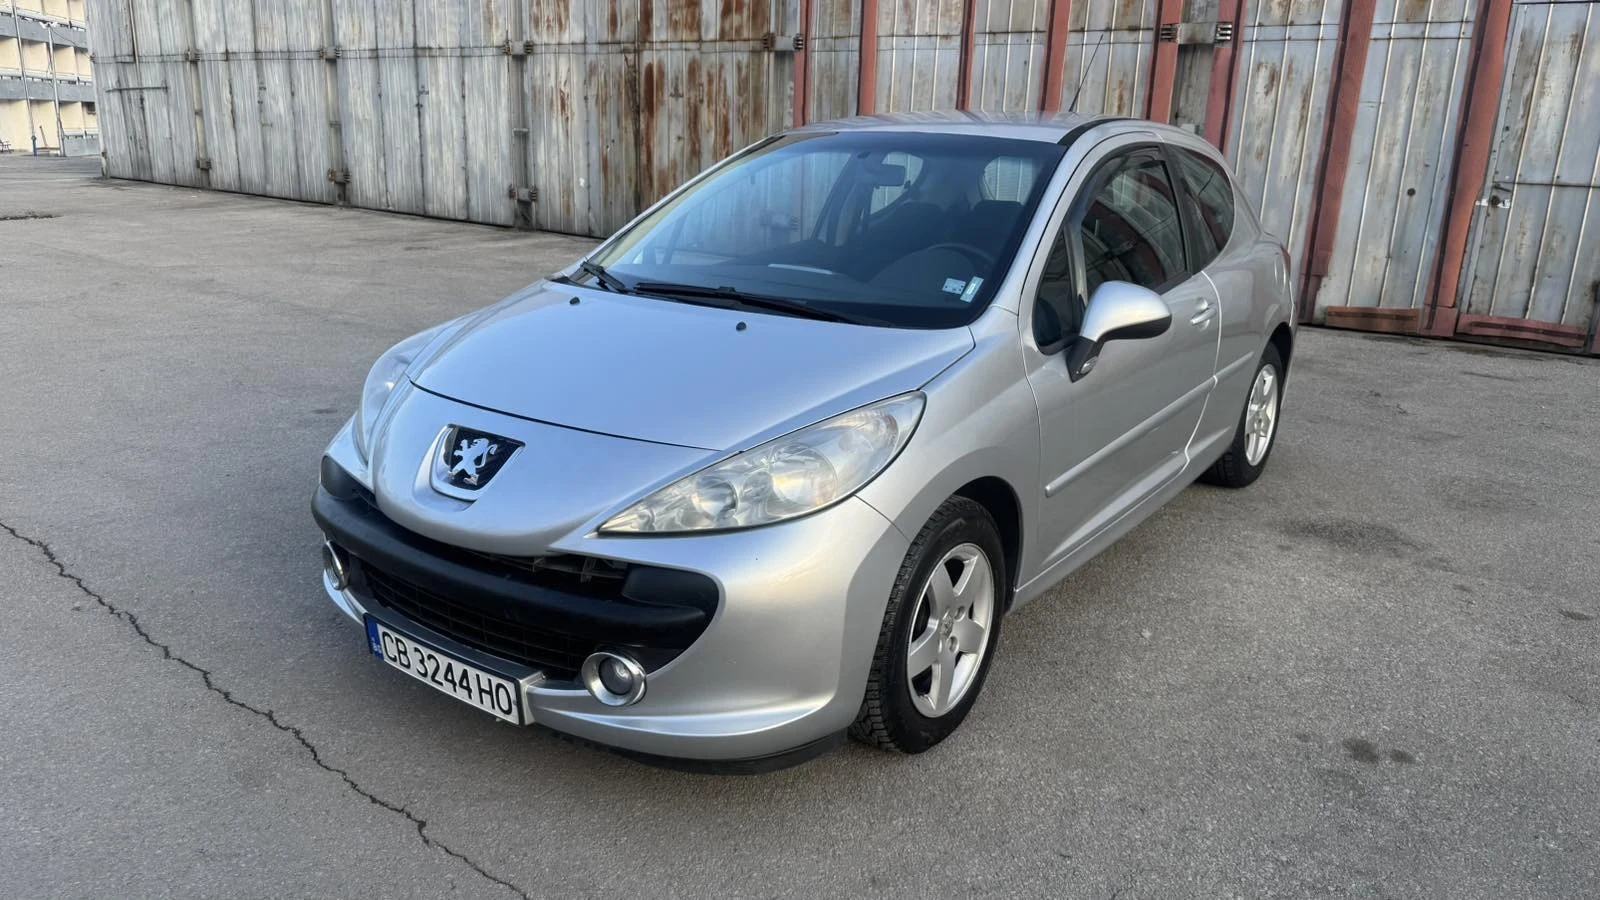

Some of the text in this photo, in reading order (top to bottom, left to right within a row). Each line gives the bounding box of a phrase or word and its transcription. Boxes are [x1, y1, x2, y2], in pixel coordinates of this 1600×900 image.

[382, 631, 513, 715] CB 3244 HO
